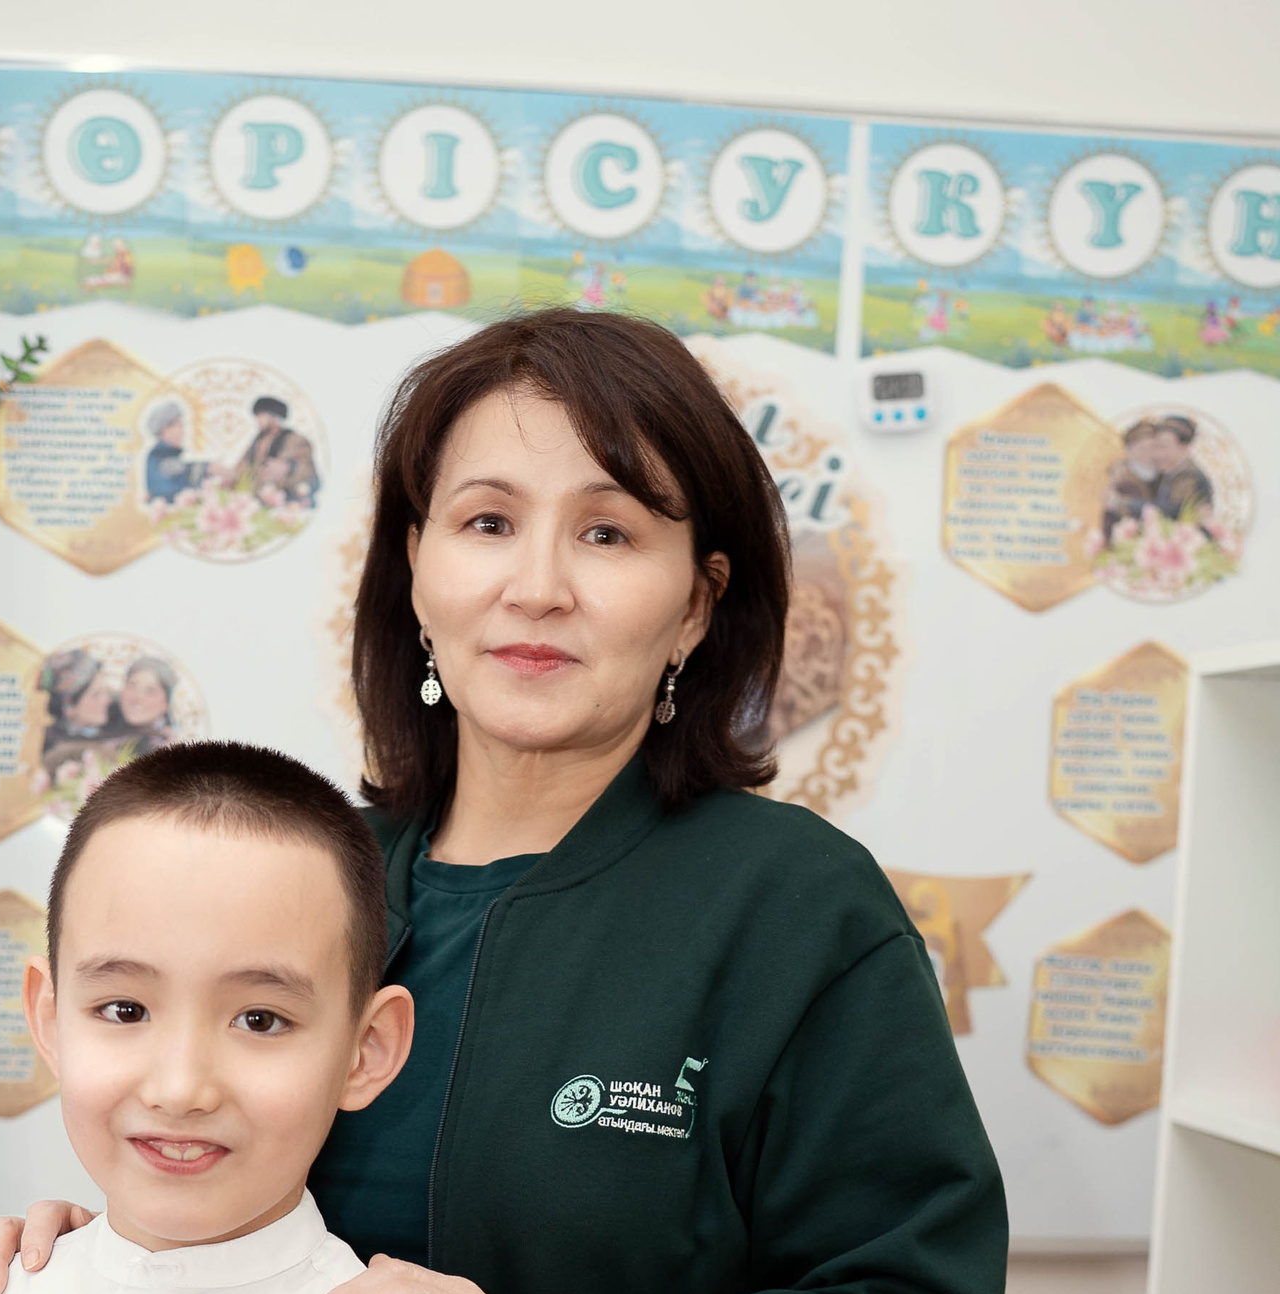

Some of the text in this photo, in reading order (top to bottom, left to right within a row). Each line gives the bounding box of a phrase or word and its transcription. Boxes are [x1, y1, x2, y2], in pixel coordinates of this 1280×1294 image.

[609, 1080, 661, 1097] ШОҚАН
[609, 1095, 683, 1117] УӘЛИХАНОВ
[597, 1115, 686, 1139] атындағы мектеп
